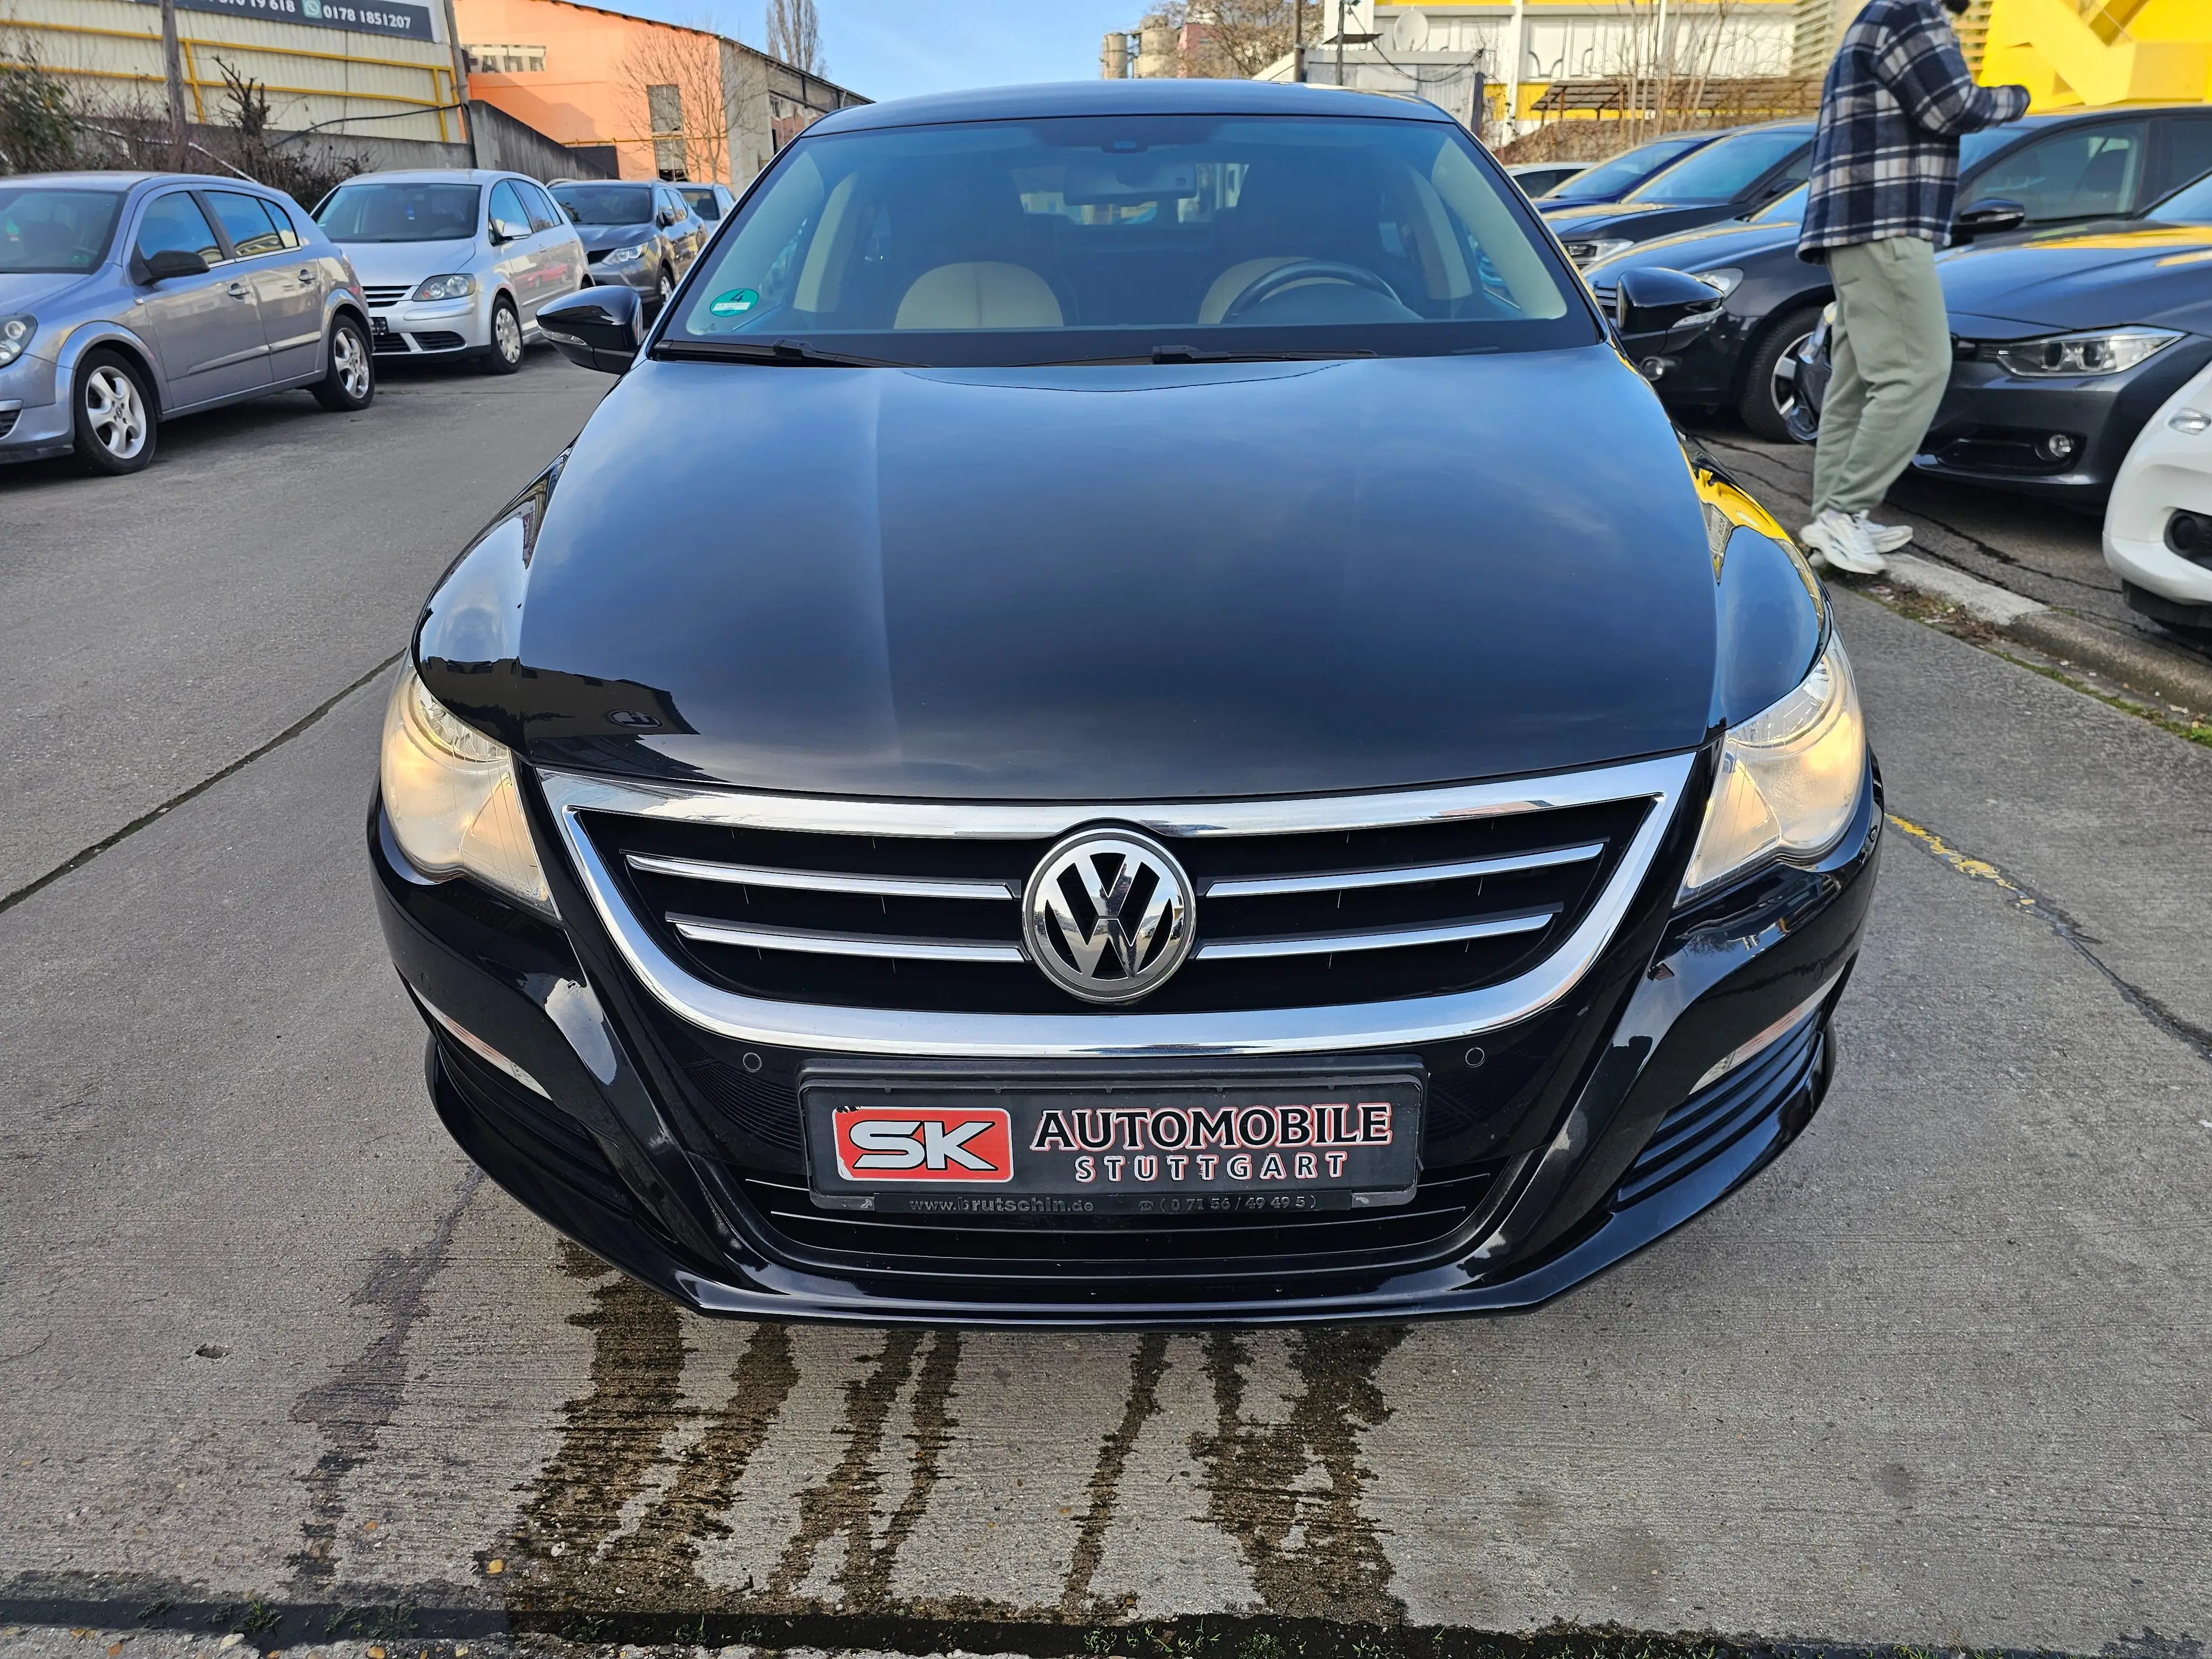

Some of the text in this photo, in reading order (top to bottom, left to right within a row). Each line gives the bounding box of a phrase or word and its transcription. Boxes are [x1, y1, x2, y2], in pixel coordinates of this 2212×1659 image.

[269, 0, 296, 13] 618
[323, 5, 411, 29] 0178 1851207
[730, 289, 745, 302] 4
[1029, 1103, 1393, 1152] AUTOMOBILE
[849, 1120, 999, 1171] SK
[1074, 1151, 1348, 1182] STUTTGART
[909, 1197, 1094, 1212] www.brutschin.de
